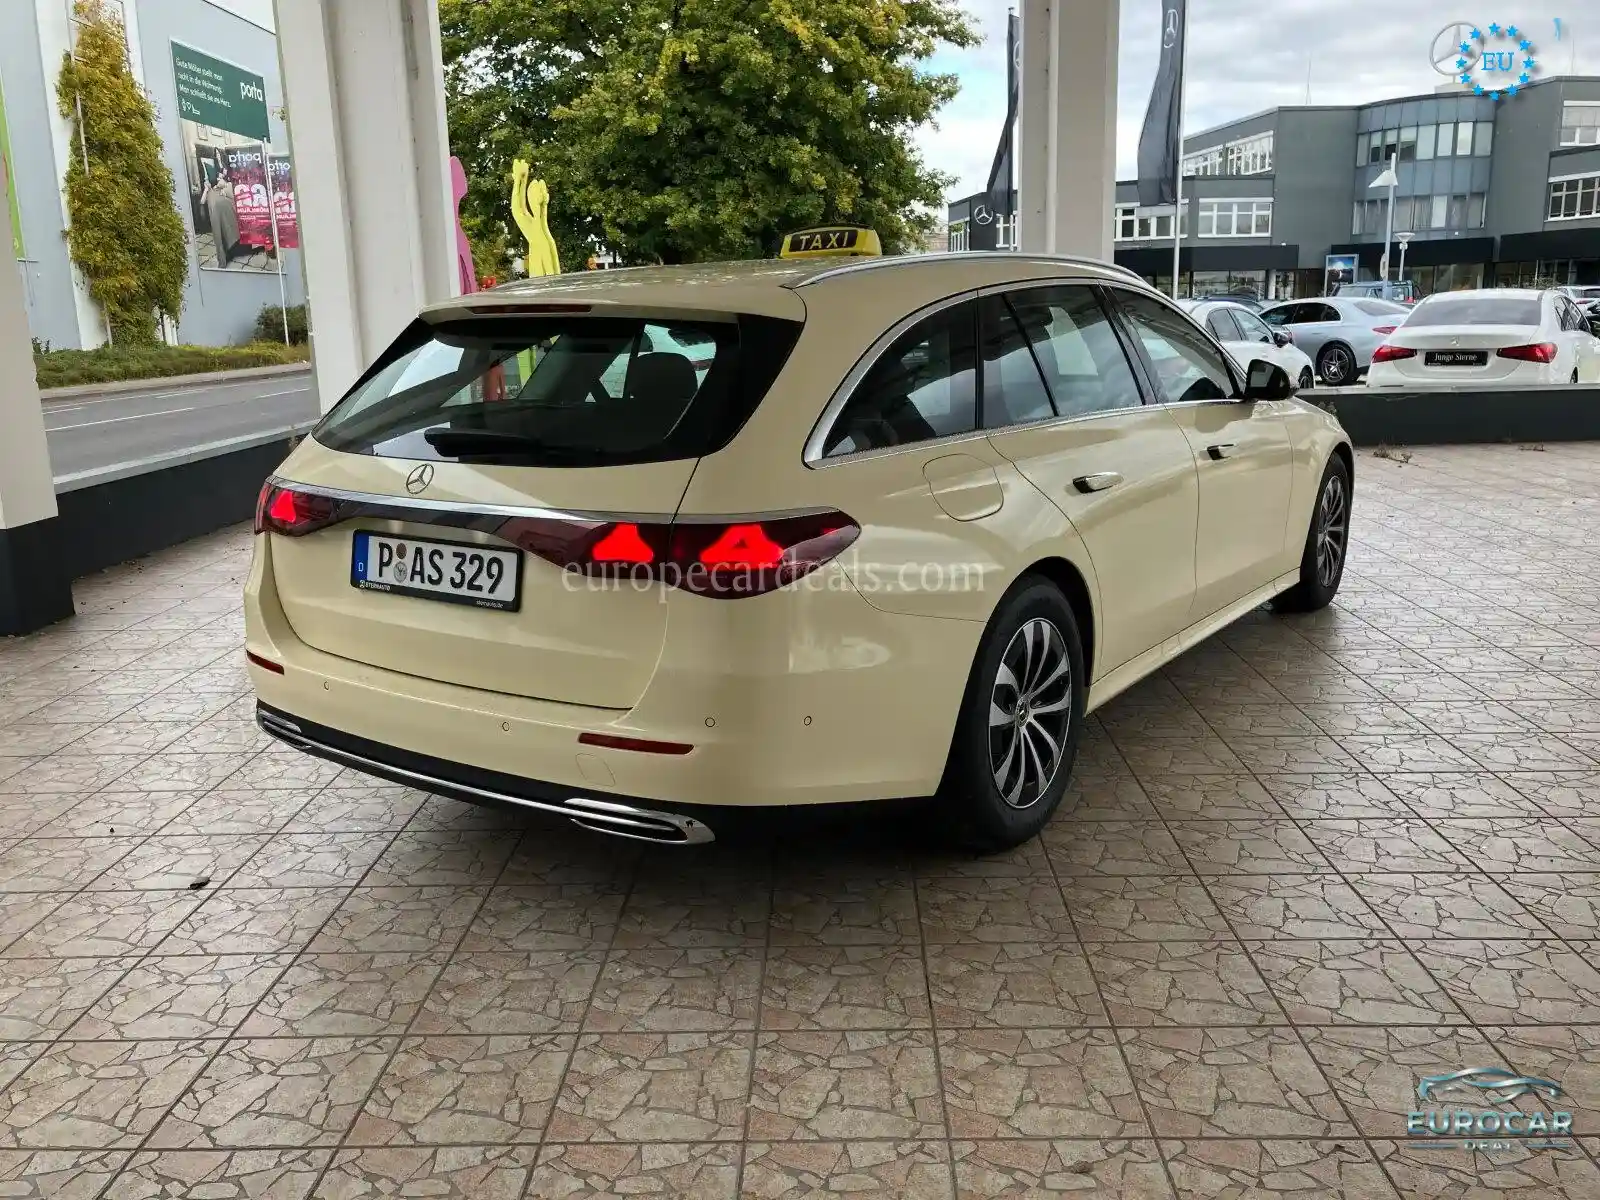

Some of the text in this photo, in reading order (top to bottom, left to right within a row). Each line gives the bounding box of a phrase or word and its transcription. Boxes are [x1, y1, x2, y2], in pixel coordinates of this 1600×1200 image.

[240, 82, 264, 102] porta
[800, 231, 849, 251] TAXI
[1434, 352, 1478, 362] Junge Sterne
[358, 562, 364, 572] D
[378, 542, 504, 594] P AS 329
